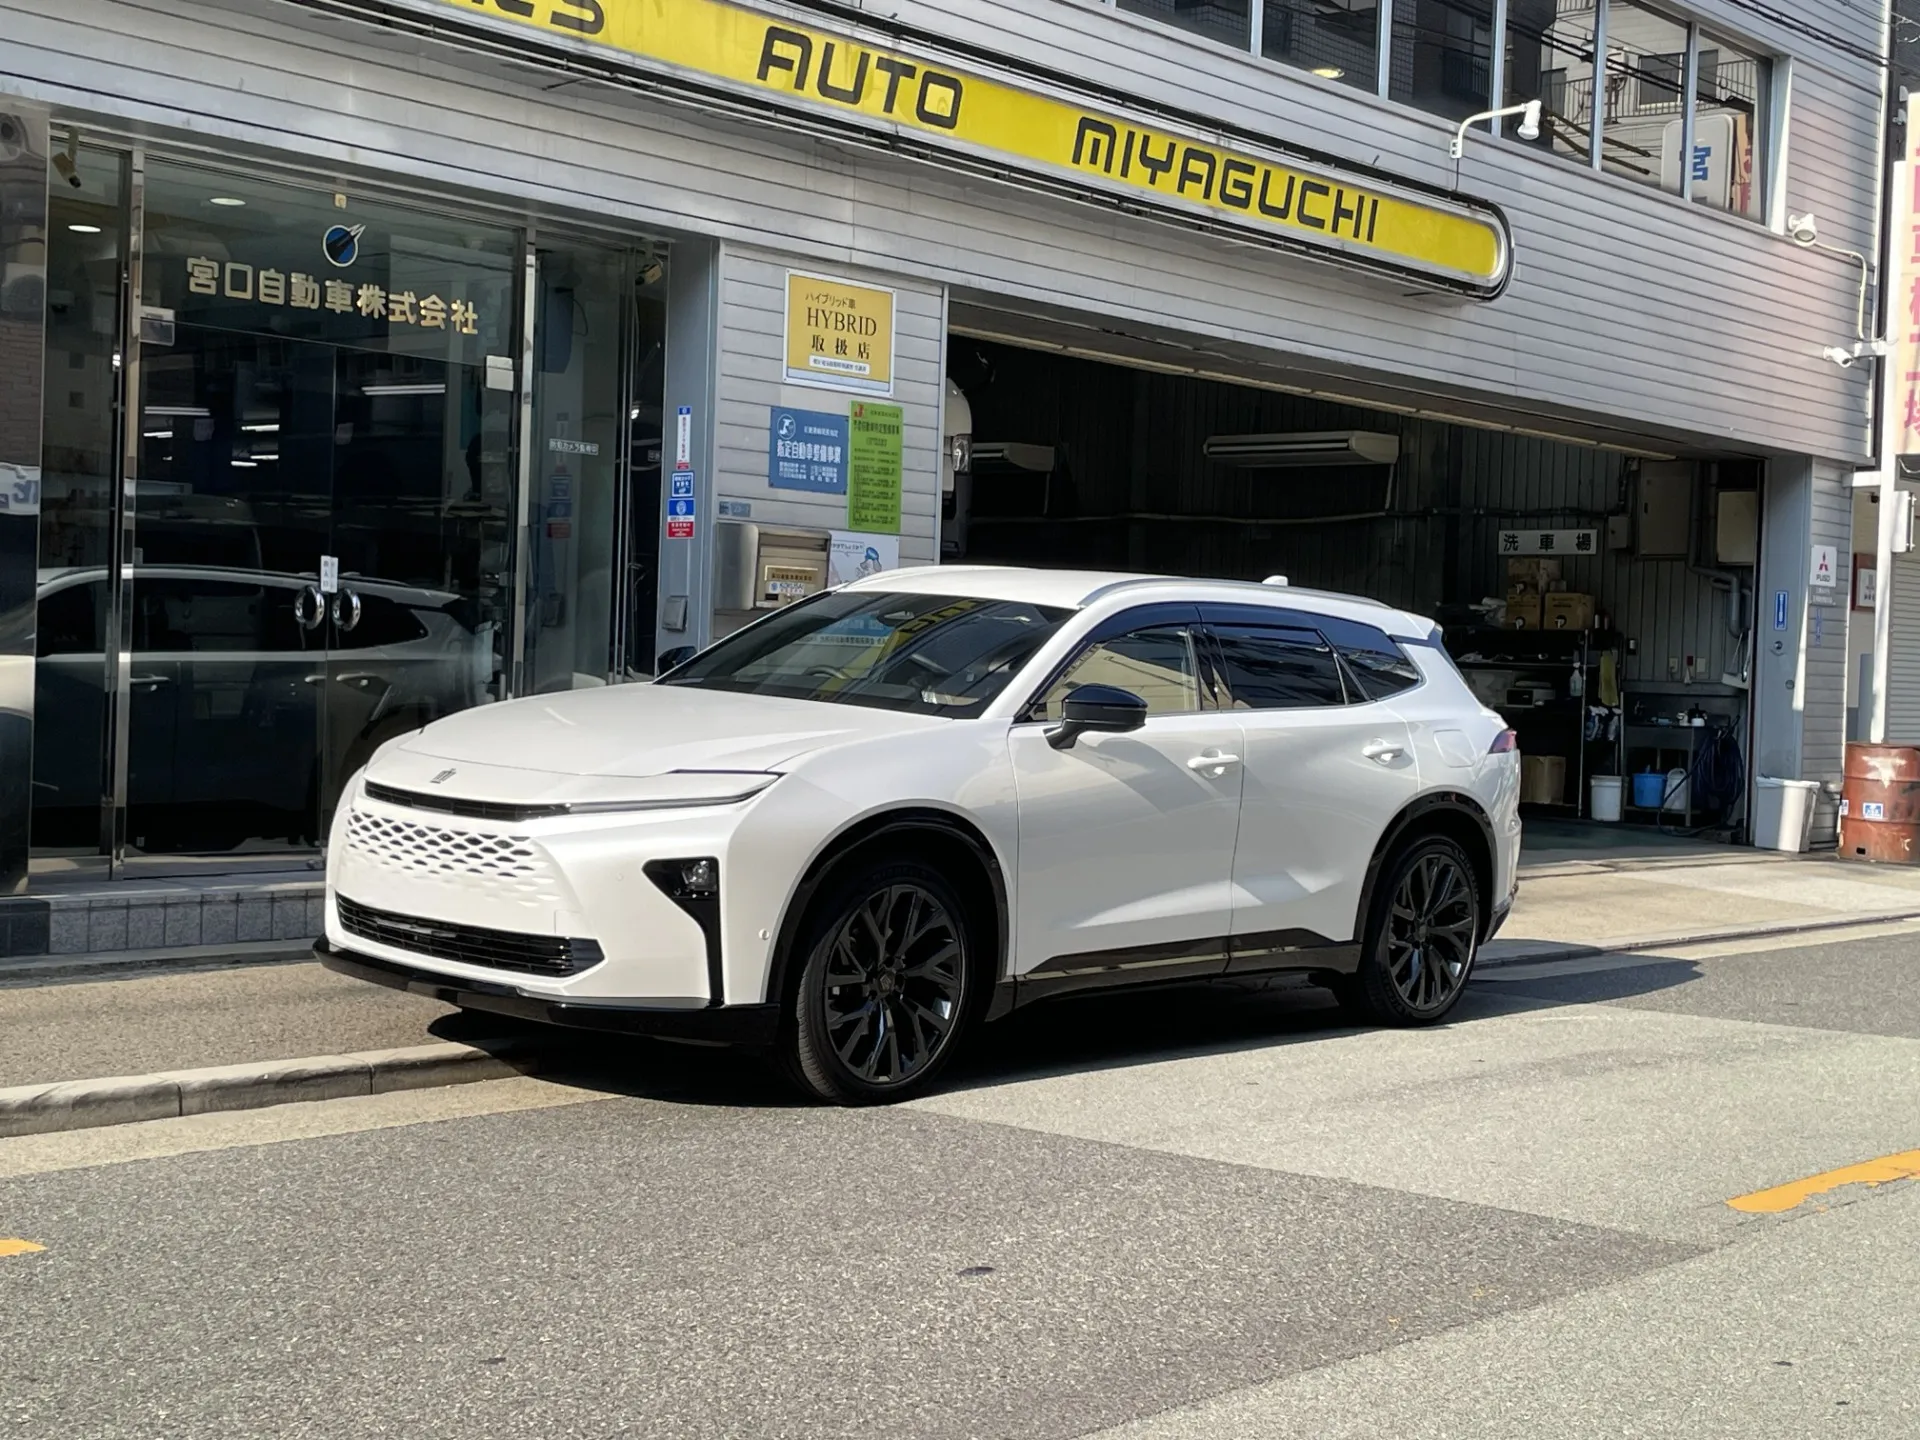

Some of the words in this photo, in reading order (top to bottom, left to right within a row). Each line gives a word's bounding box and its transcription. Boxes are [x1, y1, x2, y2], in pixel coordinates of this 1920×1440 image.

[757, 26, 963, 130] AUTO
[1072, 116, 1379, 243] MIYAGUCHI
[186, 256, 479, 335] 宮口自動車株式会社
[806, 306, 877, 337] HYBRID
[811, 334, 871, 360] 取扱店
[1503, 532, 1592, 552] 洗車場
